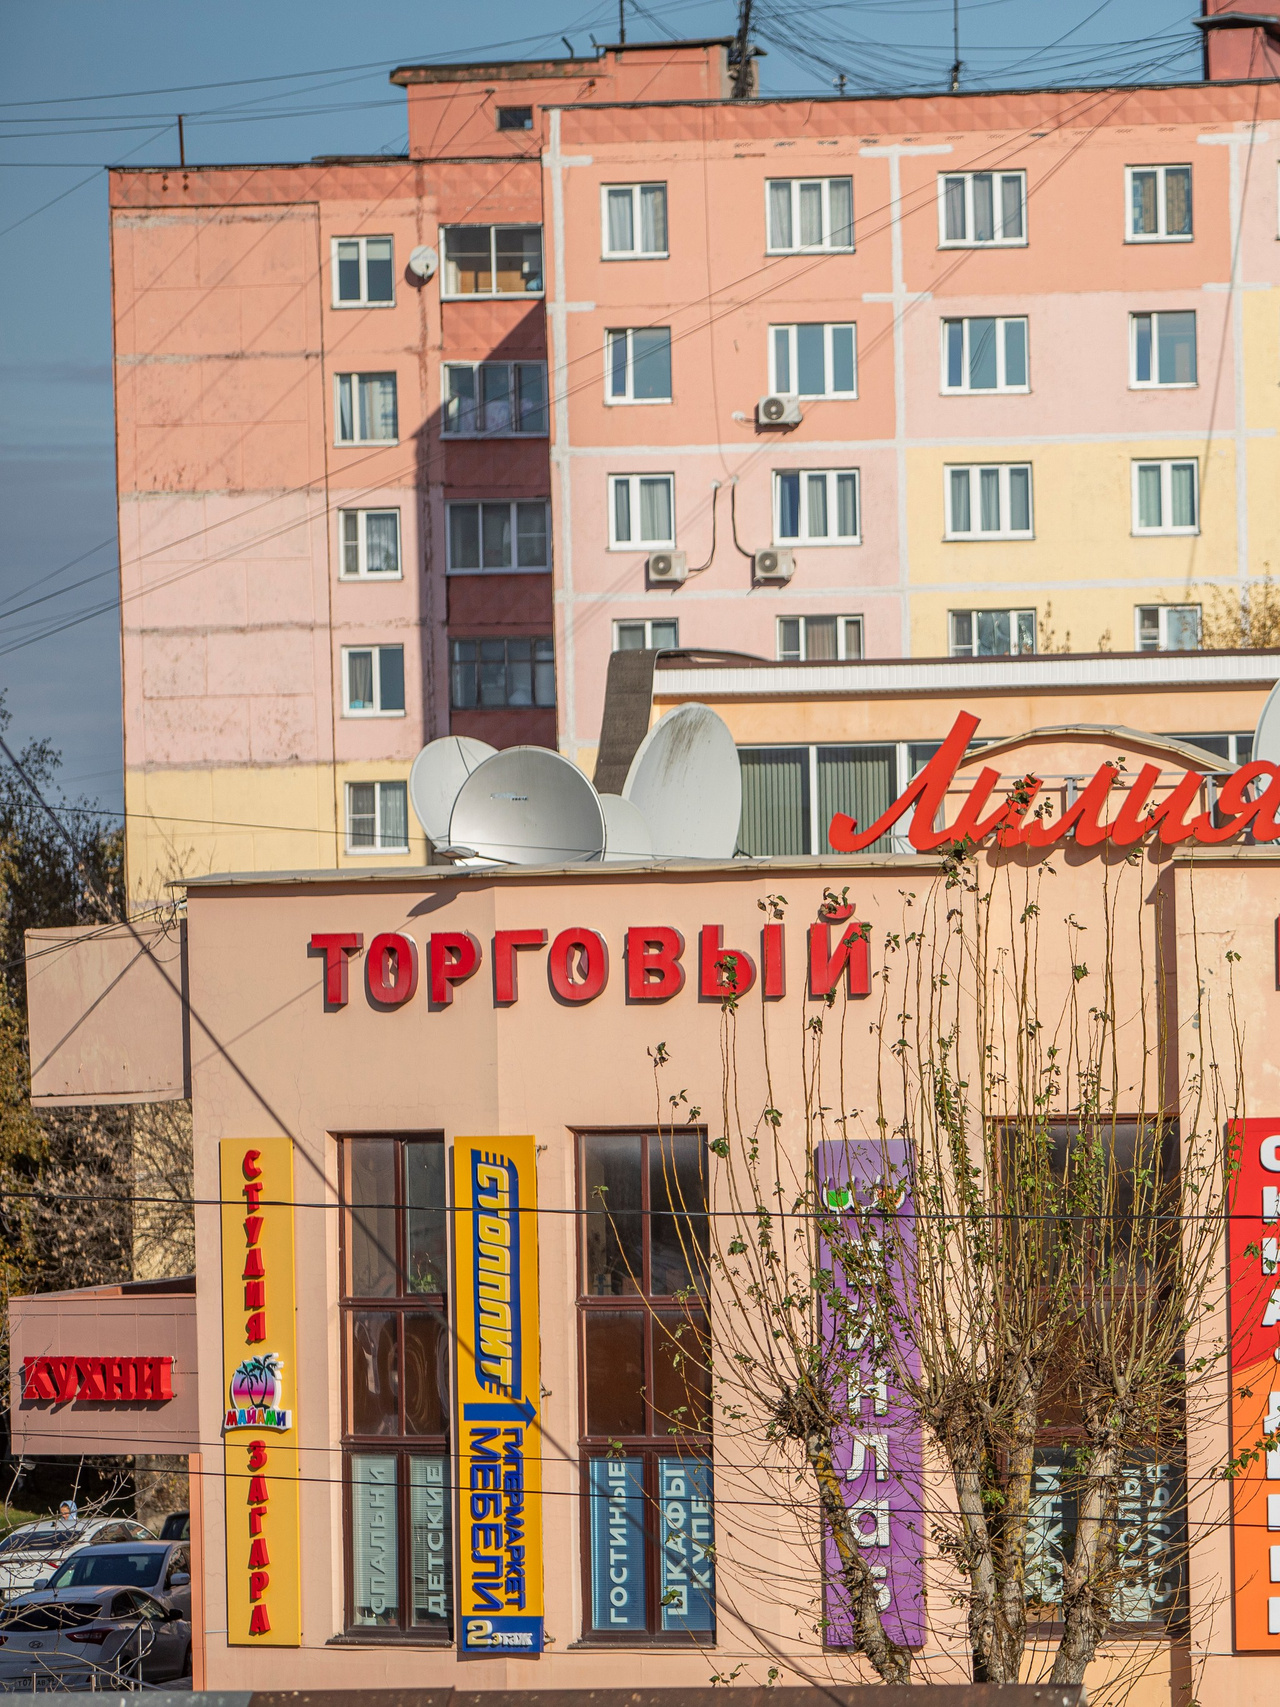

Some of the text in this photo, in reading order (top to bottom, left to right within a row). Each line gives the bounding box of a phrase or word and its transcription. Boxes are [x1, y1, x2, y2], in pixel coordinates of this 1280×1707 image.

[309, 903, 873, 1005] ТОРГОВЫЙ
[243, 1149, 267, 1343] СТУДИЯ
[477, 1163, 512, 1387] СТОЛПЛИТ
[23, 1356, 172, 1405] КУХНИ
[225, 1406, 287, 1427] МАЙАМИ
[248, 1440, 272, 1633] ЗАГАРА
[368, 1467, 386, 1615] СПАЛЬНИ
[426, 1465, 448, 1618] ДЕТСКИЕ
[469, 1427, 505, 1612] МЕБЕЛИ
[503, 1427, 526, 1611] ГИПЕРМАРКЕТ
[608, 1461, 629, 1624] ГОСТИНЫЕ
[664, 1469, 689, 1616] ШКАФЫ
[690, 1494, 713, 1589] КУПЕ
[467, 1620, 533, 1646] 2 этаж
